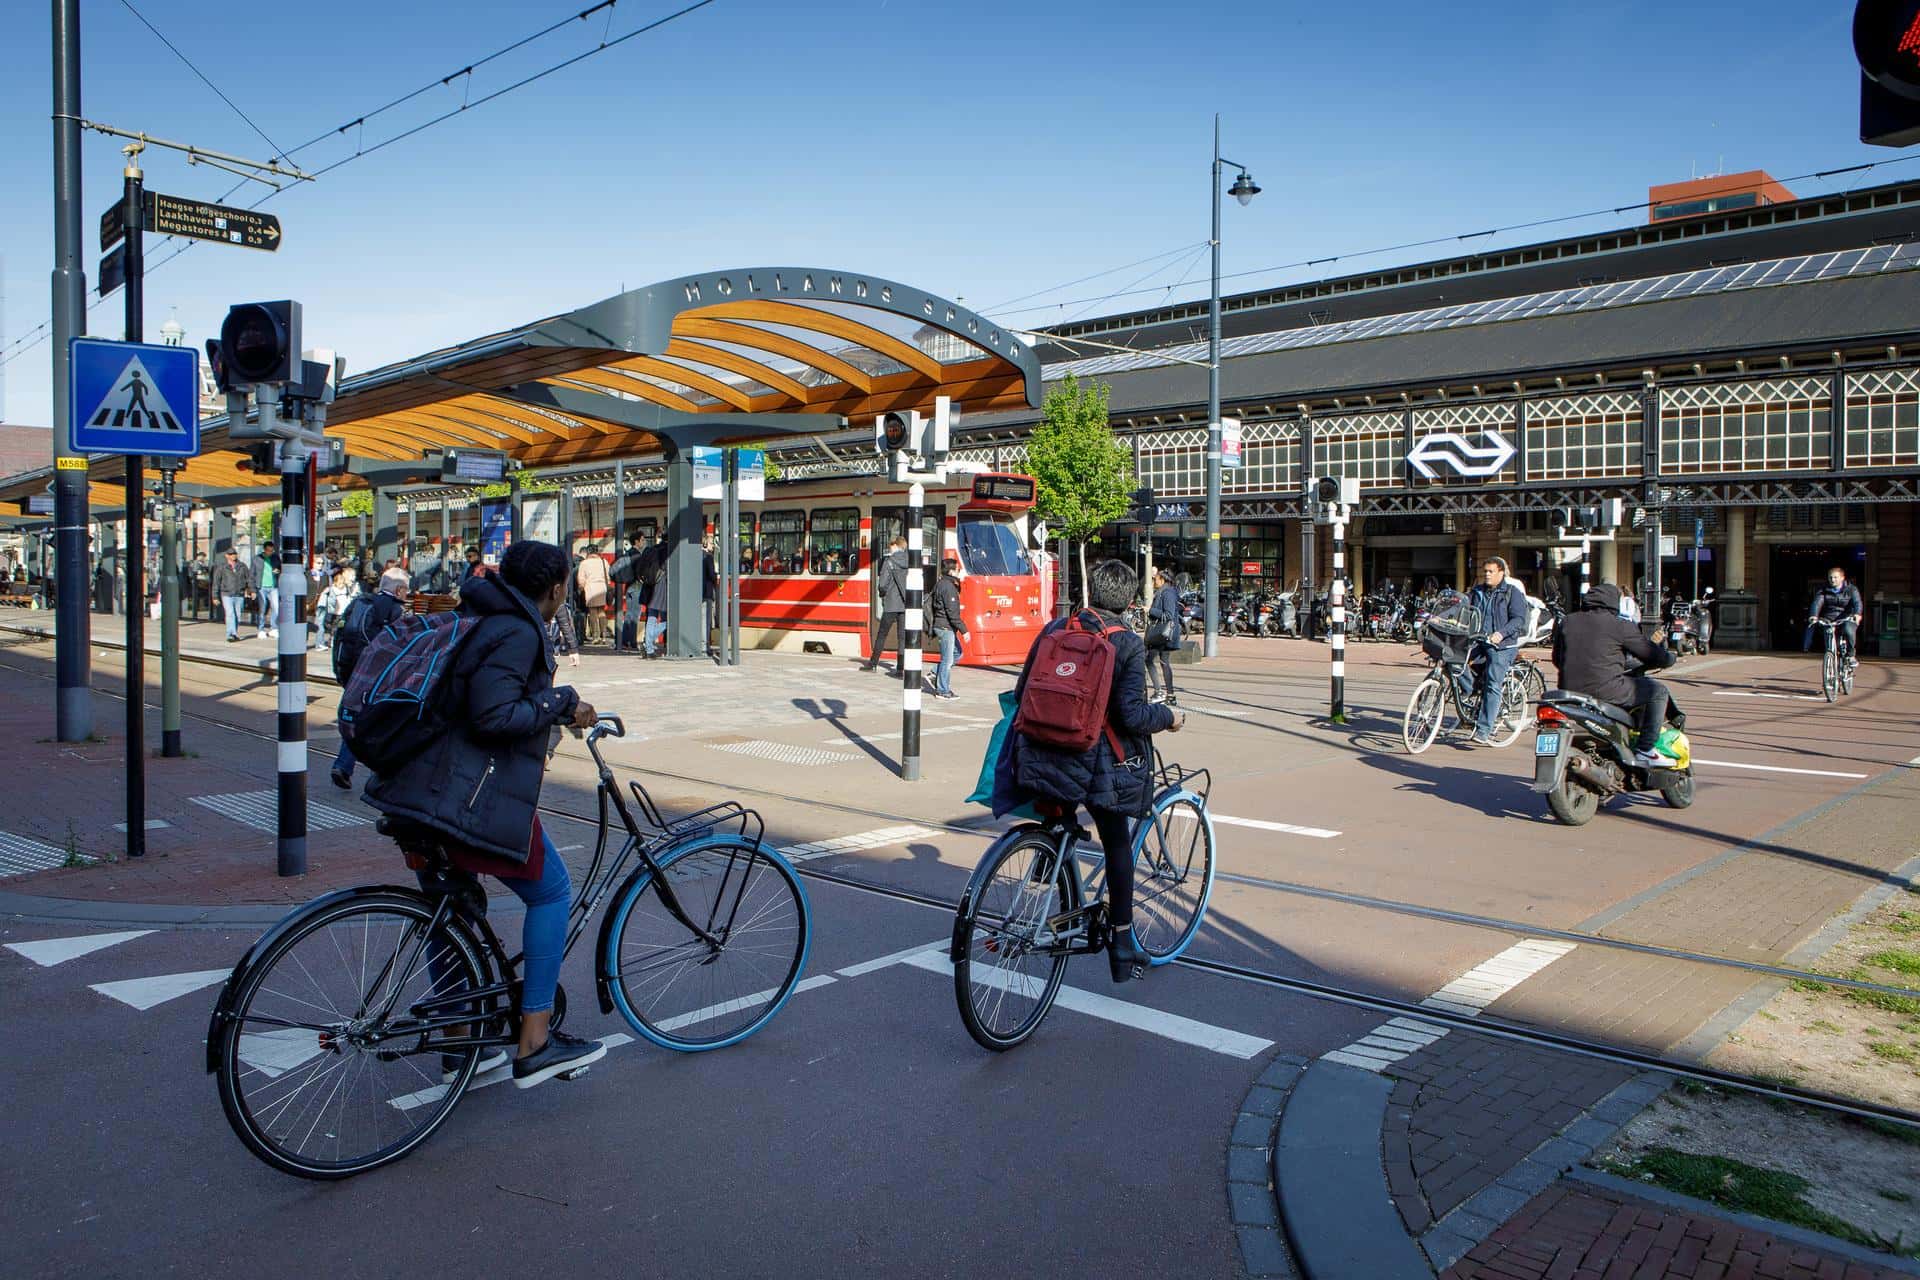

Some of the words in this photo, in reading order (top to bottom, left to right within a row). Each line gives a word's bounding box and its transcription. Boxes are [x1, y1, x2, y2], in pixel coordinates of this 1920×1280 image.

[160, 199, 194, 212] Haagse
[160, 209, 214, 226] Laakhaven
[160, 219, 220, 238] Megastores
[684, 273, 893, 303] HOLLANDS
[923, 298, 1020, 358] SPOOR
[333, 441, 341, 450] B
[449, 450, 456, 458] A
[755, 452, 762, 462] A
